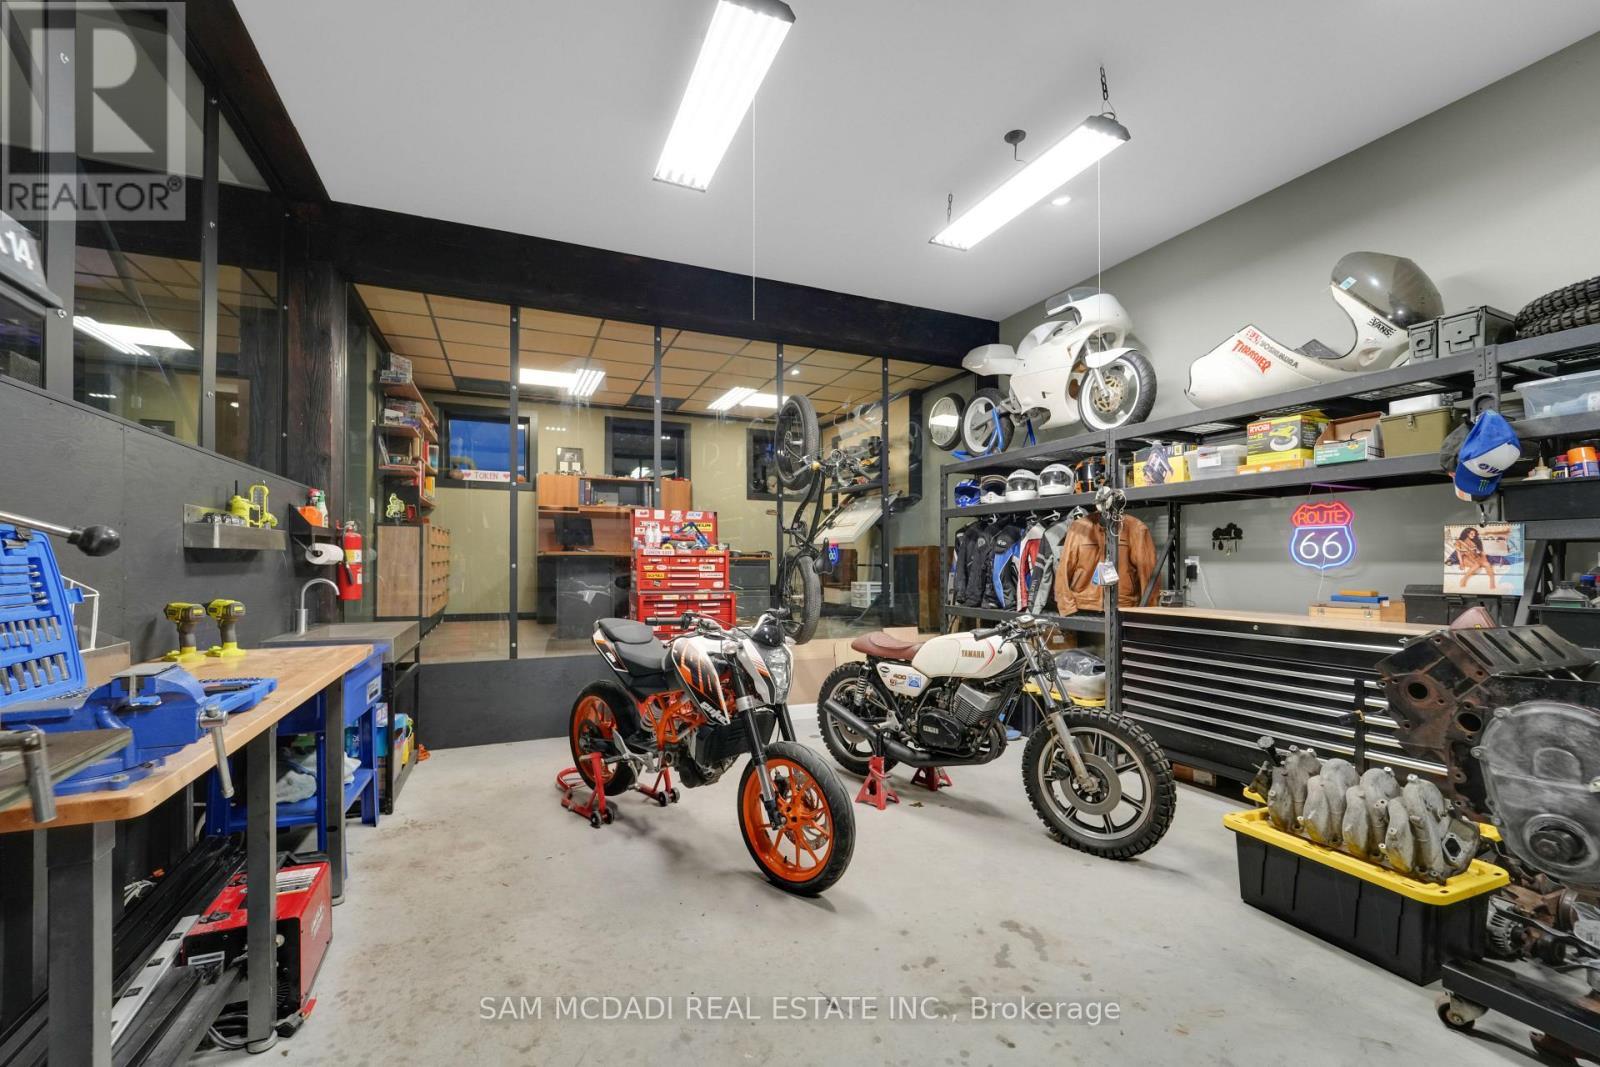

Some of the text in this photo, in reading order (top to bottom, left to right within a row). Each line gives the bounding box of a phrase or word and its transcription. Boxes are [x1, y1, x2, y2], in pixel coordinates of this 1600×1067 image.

[1369, 316, 1397, 338] VANS
[1232, 339, 1272, 374] THRASHER
[1249, 423, 1271, 434] RYOBI
[1298, 510, 1345, 524] ROUTE
[1300, 531, 1343, 559] 66
[961, 649, 985, 659] YAMAHA
